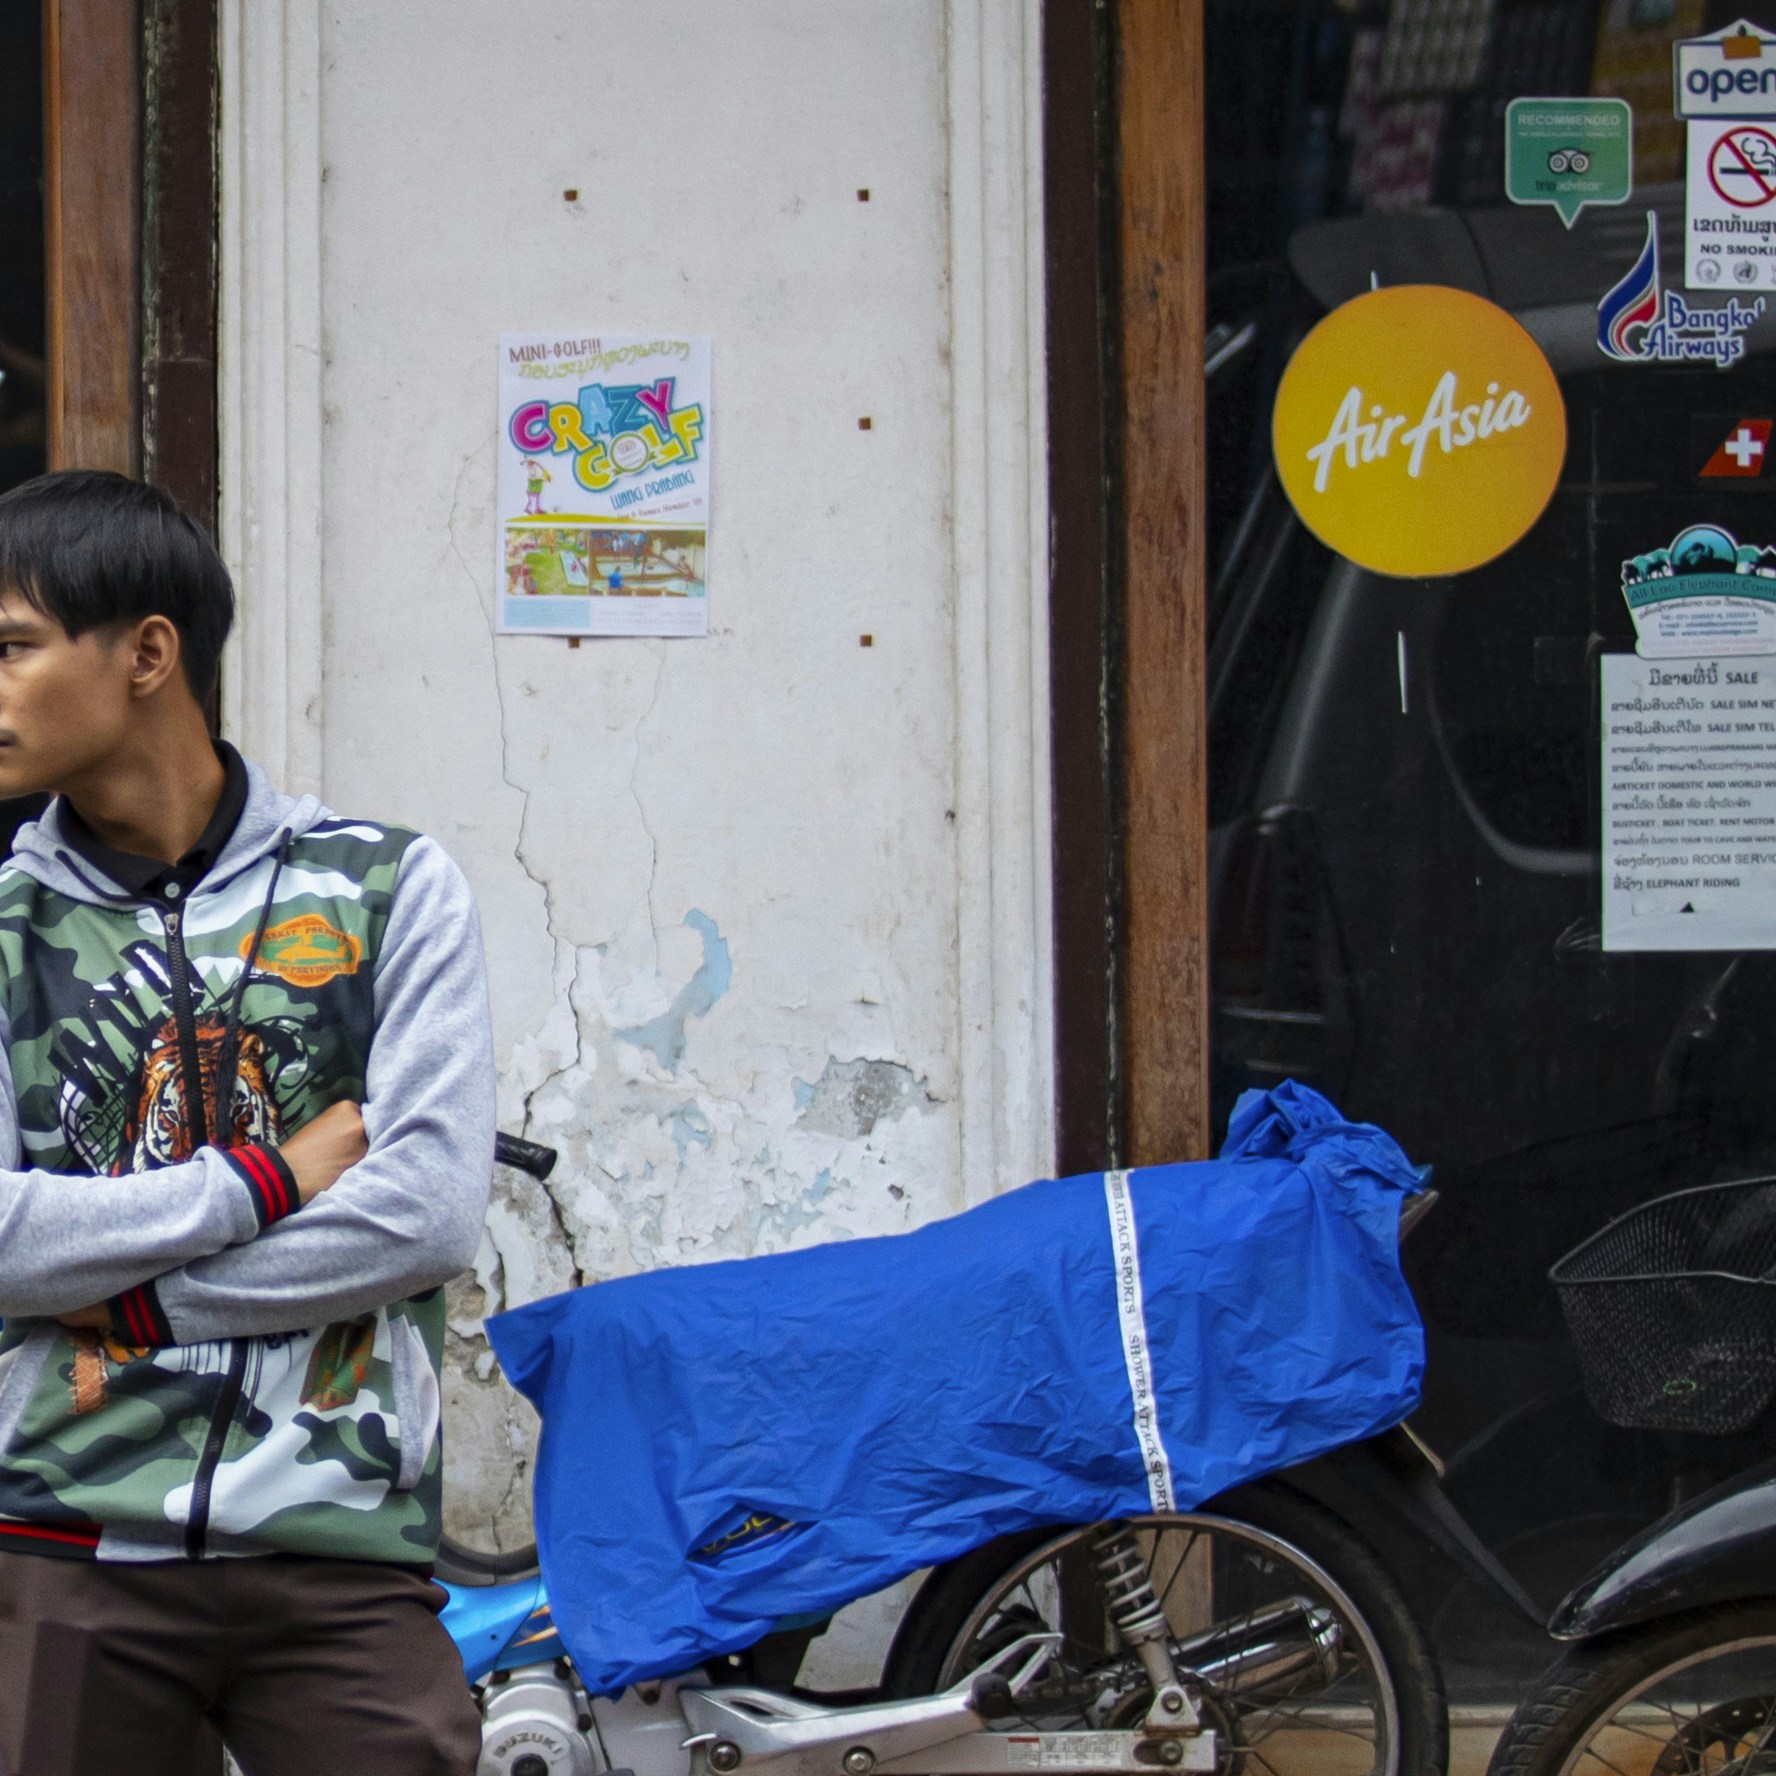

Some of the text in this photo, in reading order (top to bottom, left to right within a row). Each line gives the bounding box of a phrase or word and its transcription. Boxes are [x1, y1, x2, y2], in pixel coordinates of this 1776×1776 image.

[1686, 68, 1776, 103] open
[1518, 114, 1620, 125] RECOMMENDED
[1535, 180, 1600, 192] tripadvisor
[1700, 244, 1776, 256] NO SMOKI
[1643, 324, 1741, 364] Airways
[509, 376, 676, 455] CRAZY
[1307, 371, 1532, 493] Air Asia
[1725, 671, 1759, 684] SALE
[1710, 700, 1735, 710] SALE
[1737, 700, 1758, 709] SIM
[1706, 723, 1732, 733] SALE
[1734, 723, 1755, 732] SIM
[1706, 780, 1726, 789] AND
[1728, 780, 1762, 789] WORLD
[1692, 854, 1731, 865] ROOM
[1734, 853, 1776, 865] SERVI
[1646, 878, 1700, 889] ELEPHANT
[1702, 878, 1740, 888] RIDING
[1114, 1201, 1131, 1252] ATTACK
[1120, 1255, 1136, 1315] SPORTS
[1129, 1334, 1146, 1399] SHOWER
[1138, 1400, 1159, 1457] ATTACK
[492, 1731, 563, 1758] SUZUKI
